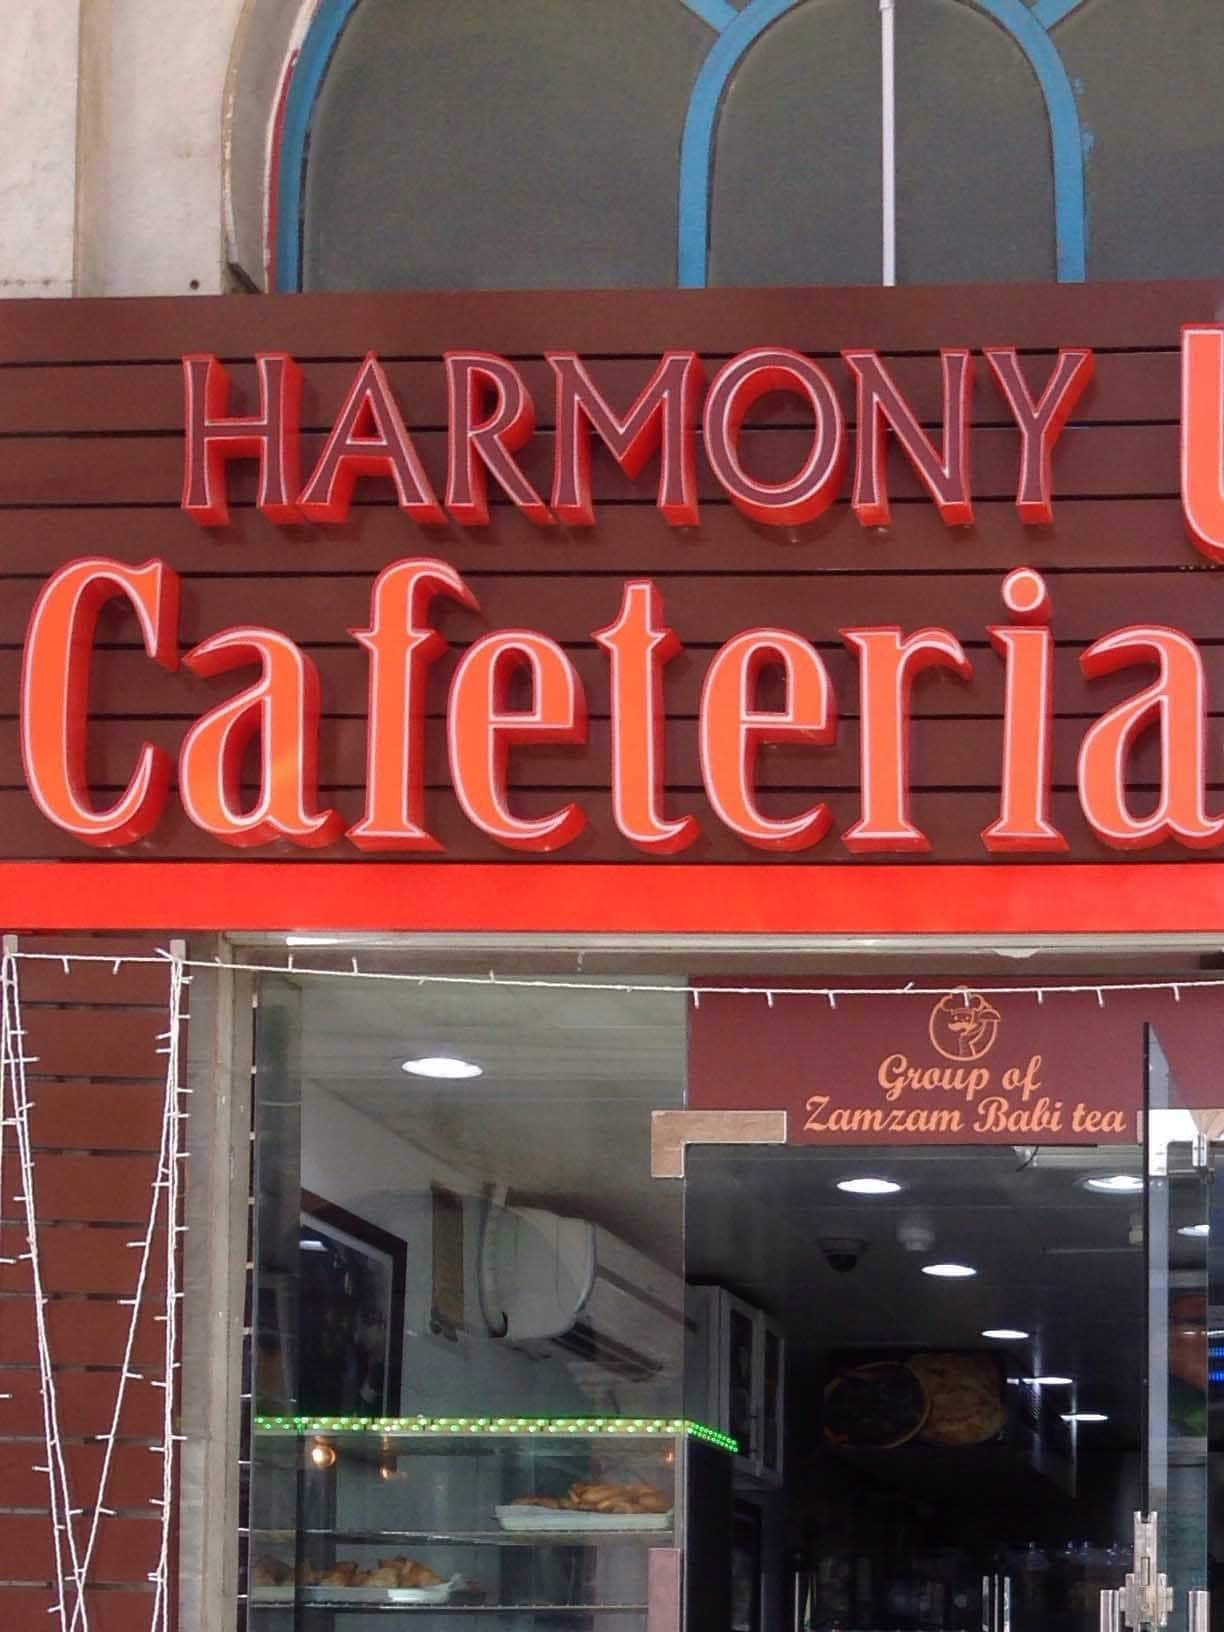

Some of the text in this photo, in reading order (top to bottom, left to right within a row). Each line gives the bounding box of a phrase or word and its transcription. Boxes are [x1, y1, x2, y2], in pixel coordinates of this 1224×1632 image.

[181, 346, 1092, 527] HARMONY
[878, 1054, 1042, 1101] Group of
[803, 1095, 1128, 1132] Zamzam Babi tea
